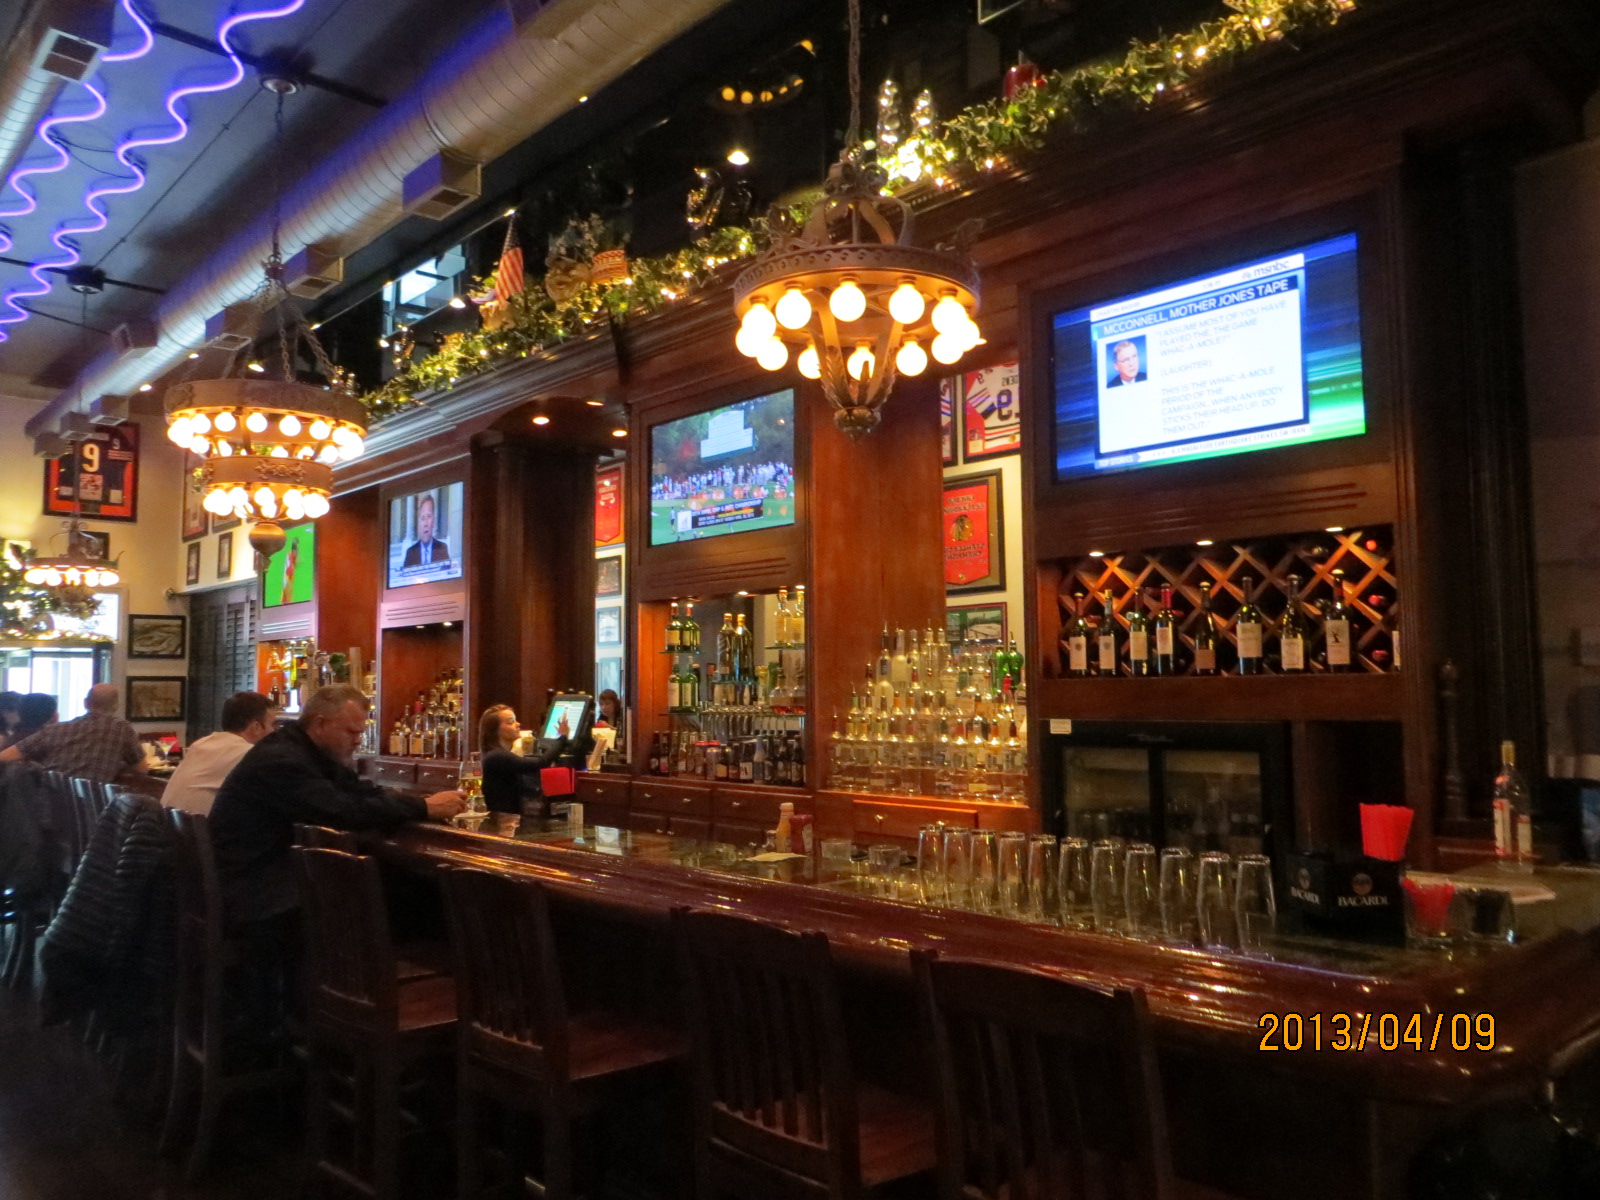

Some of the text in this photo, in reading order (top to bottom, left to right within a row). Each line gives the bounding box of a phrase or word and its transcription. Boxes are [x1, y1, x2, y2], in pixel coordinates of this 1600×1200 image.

[1253, 261, 1289, 277] msnbc
[1103, 278, 1289, 336] MCCONNELL, MOTHER JONES TAPE
[82, 443, 100, 473] 9
[1337, 895, 1389, 907] BACARDI
